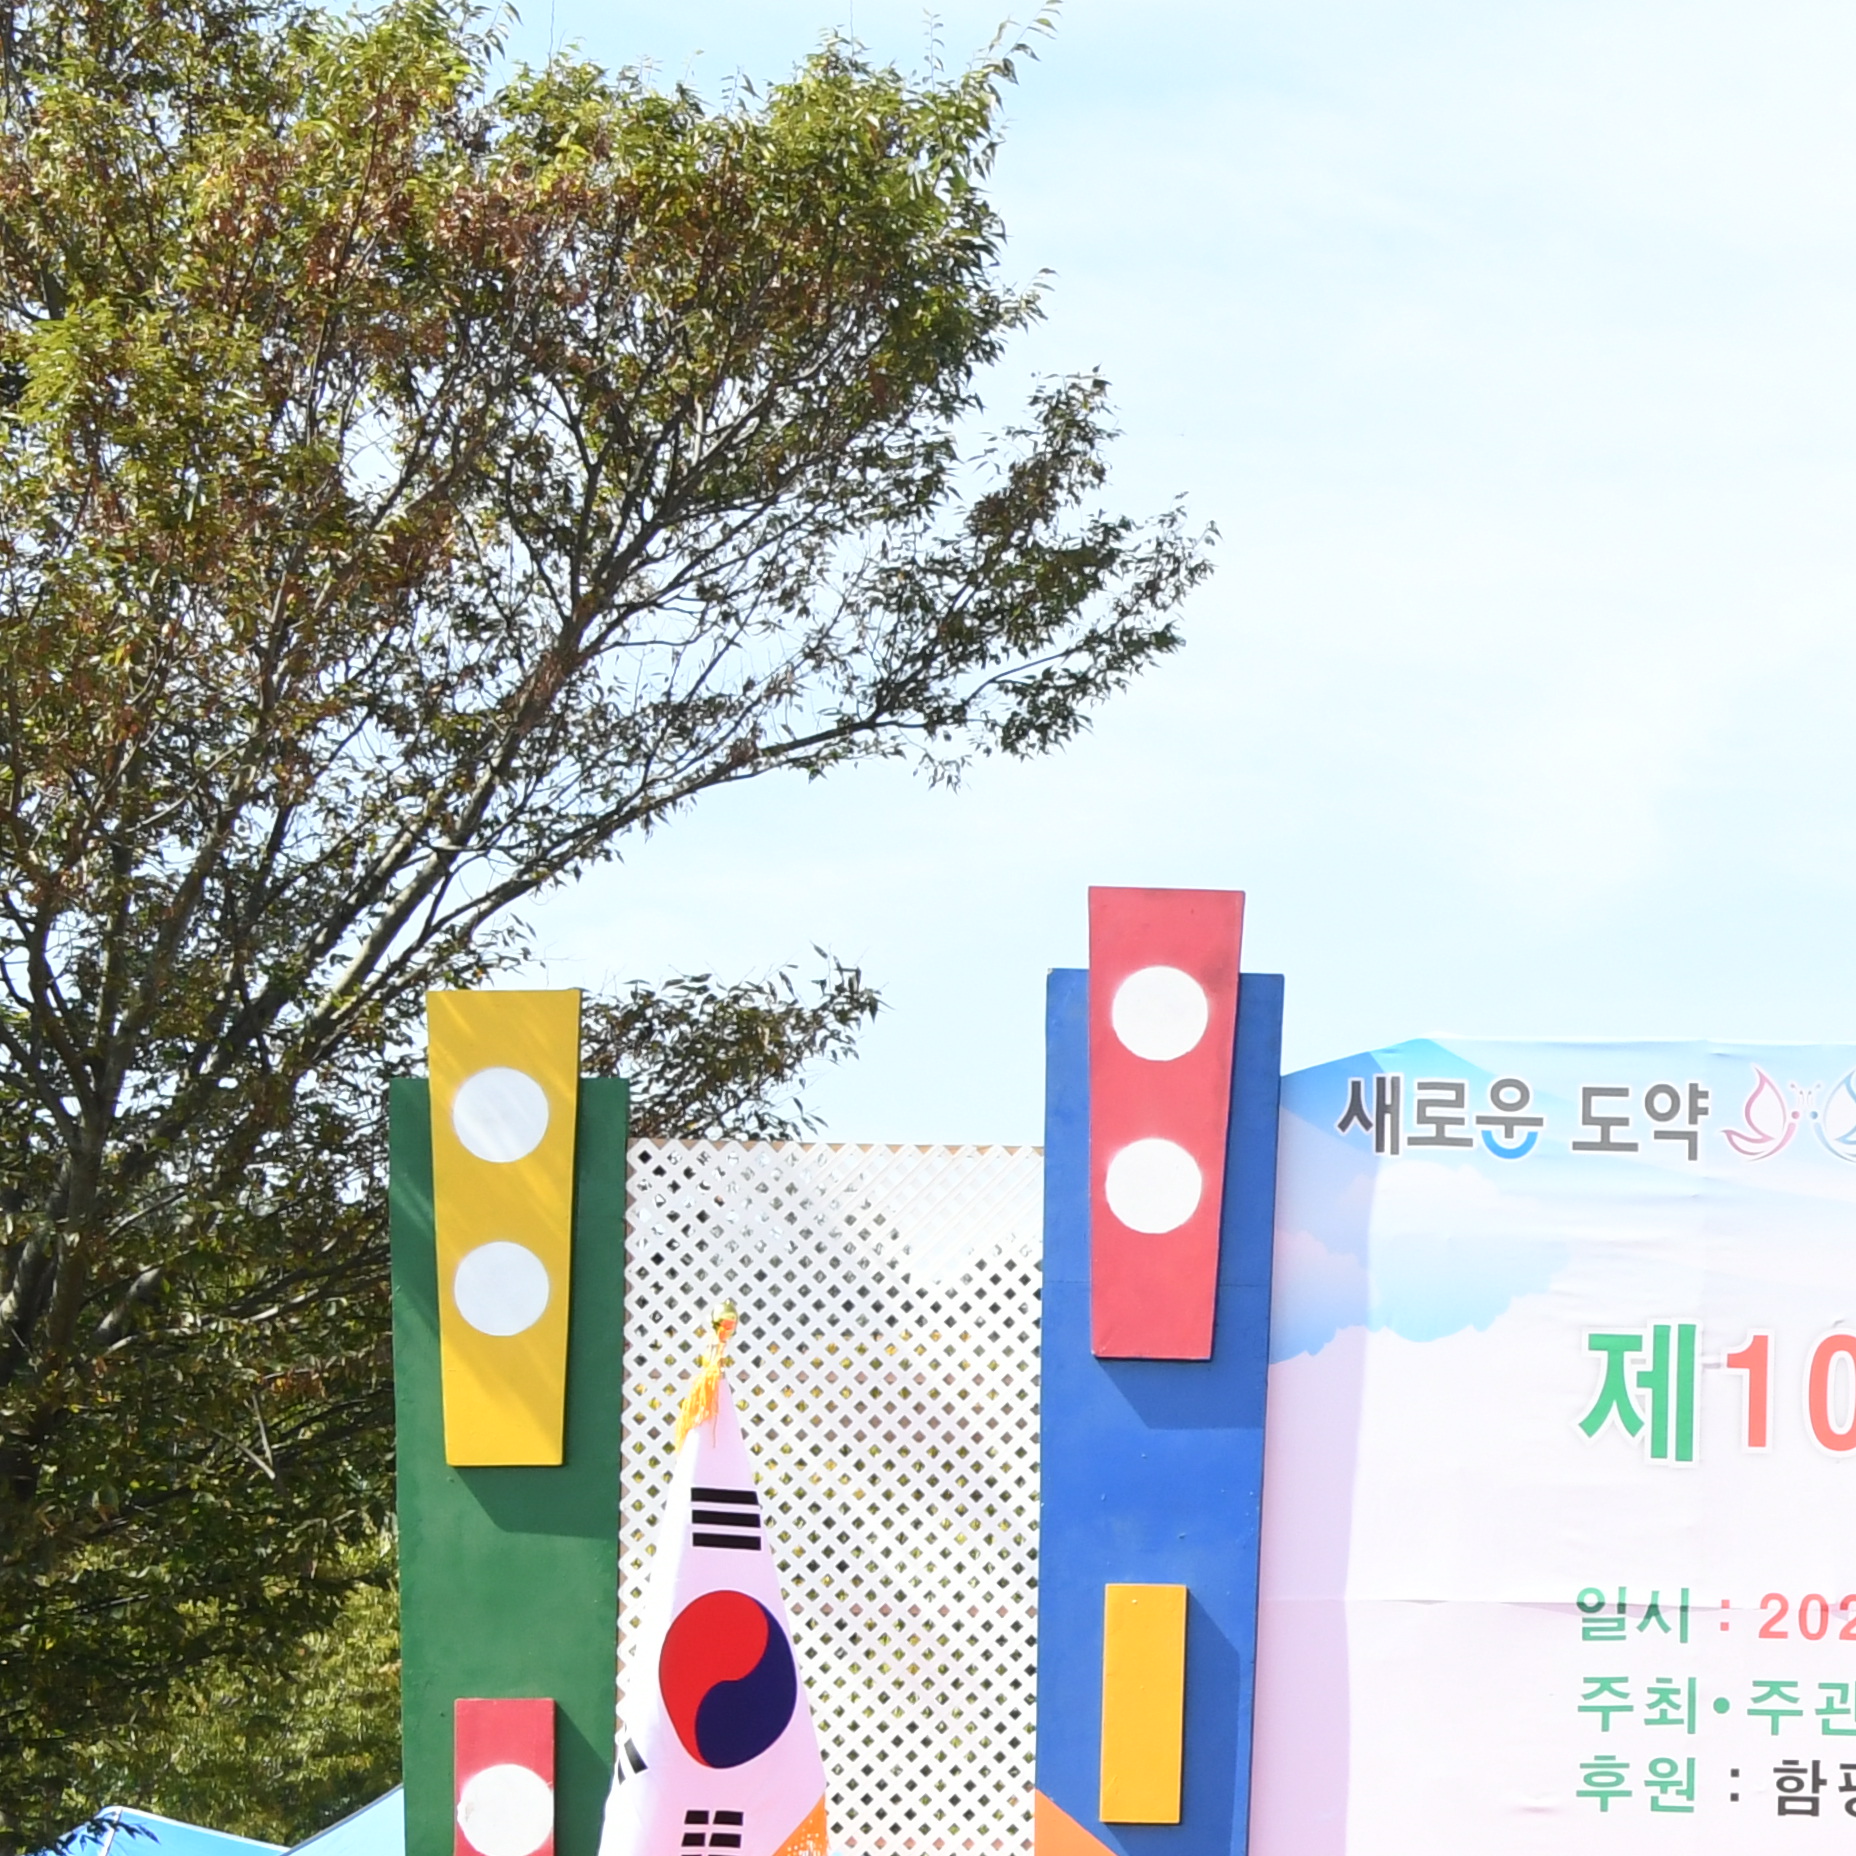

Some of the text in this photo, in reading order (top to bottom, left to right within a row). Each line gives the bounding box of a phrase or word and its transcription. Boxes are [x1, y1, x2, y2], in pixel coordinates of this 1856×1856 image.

[1338, 1075, 1709, 1161] 새로운 도약
[1575, 1586, 1691, 1644] 일시
[1576, 1754, 1696, 1813] 후원
